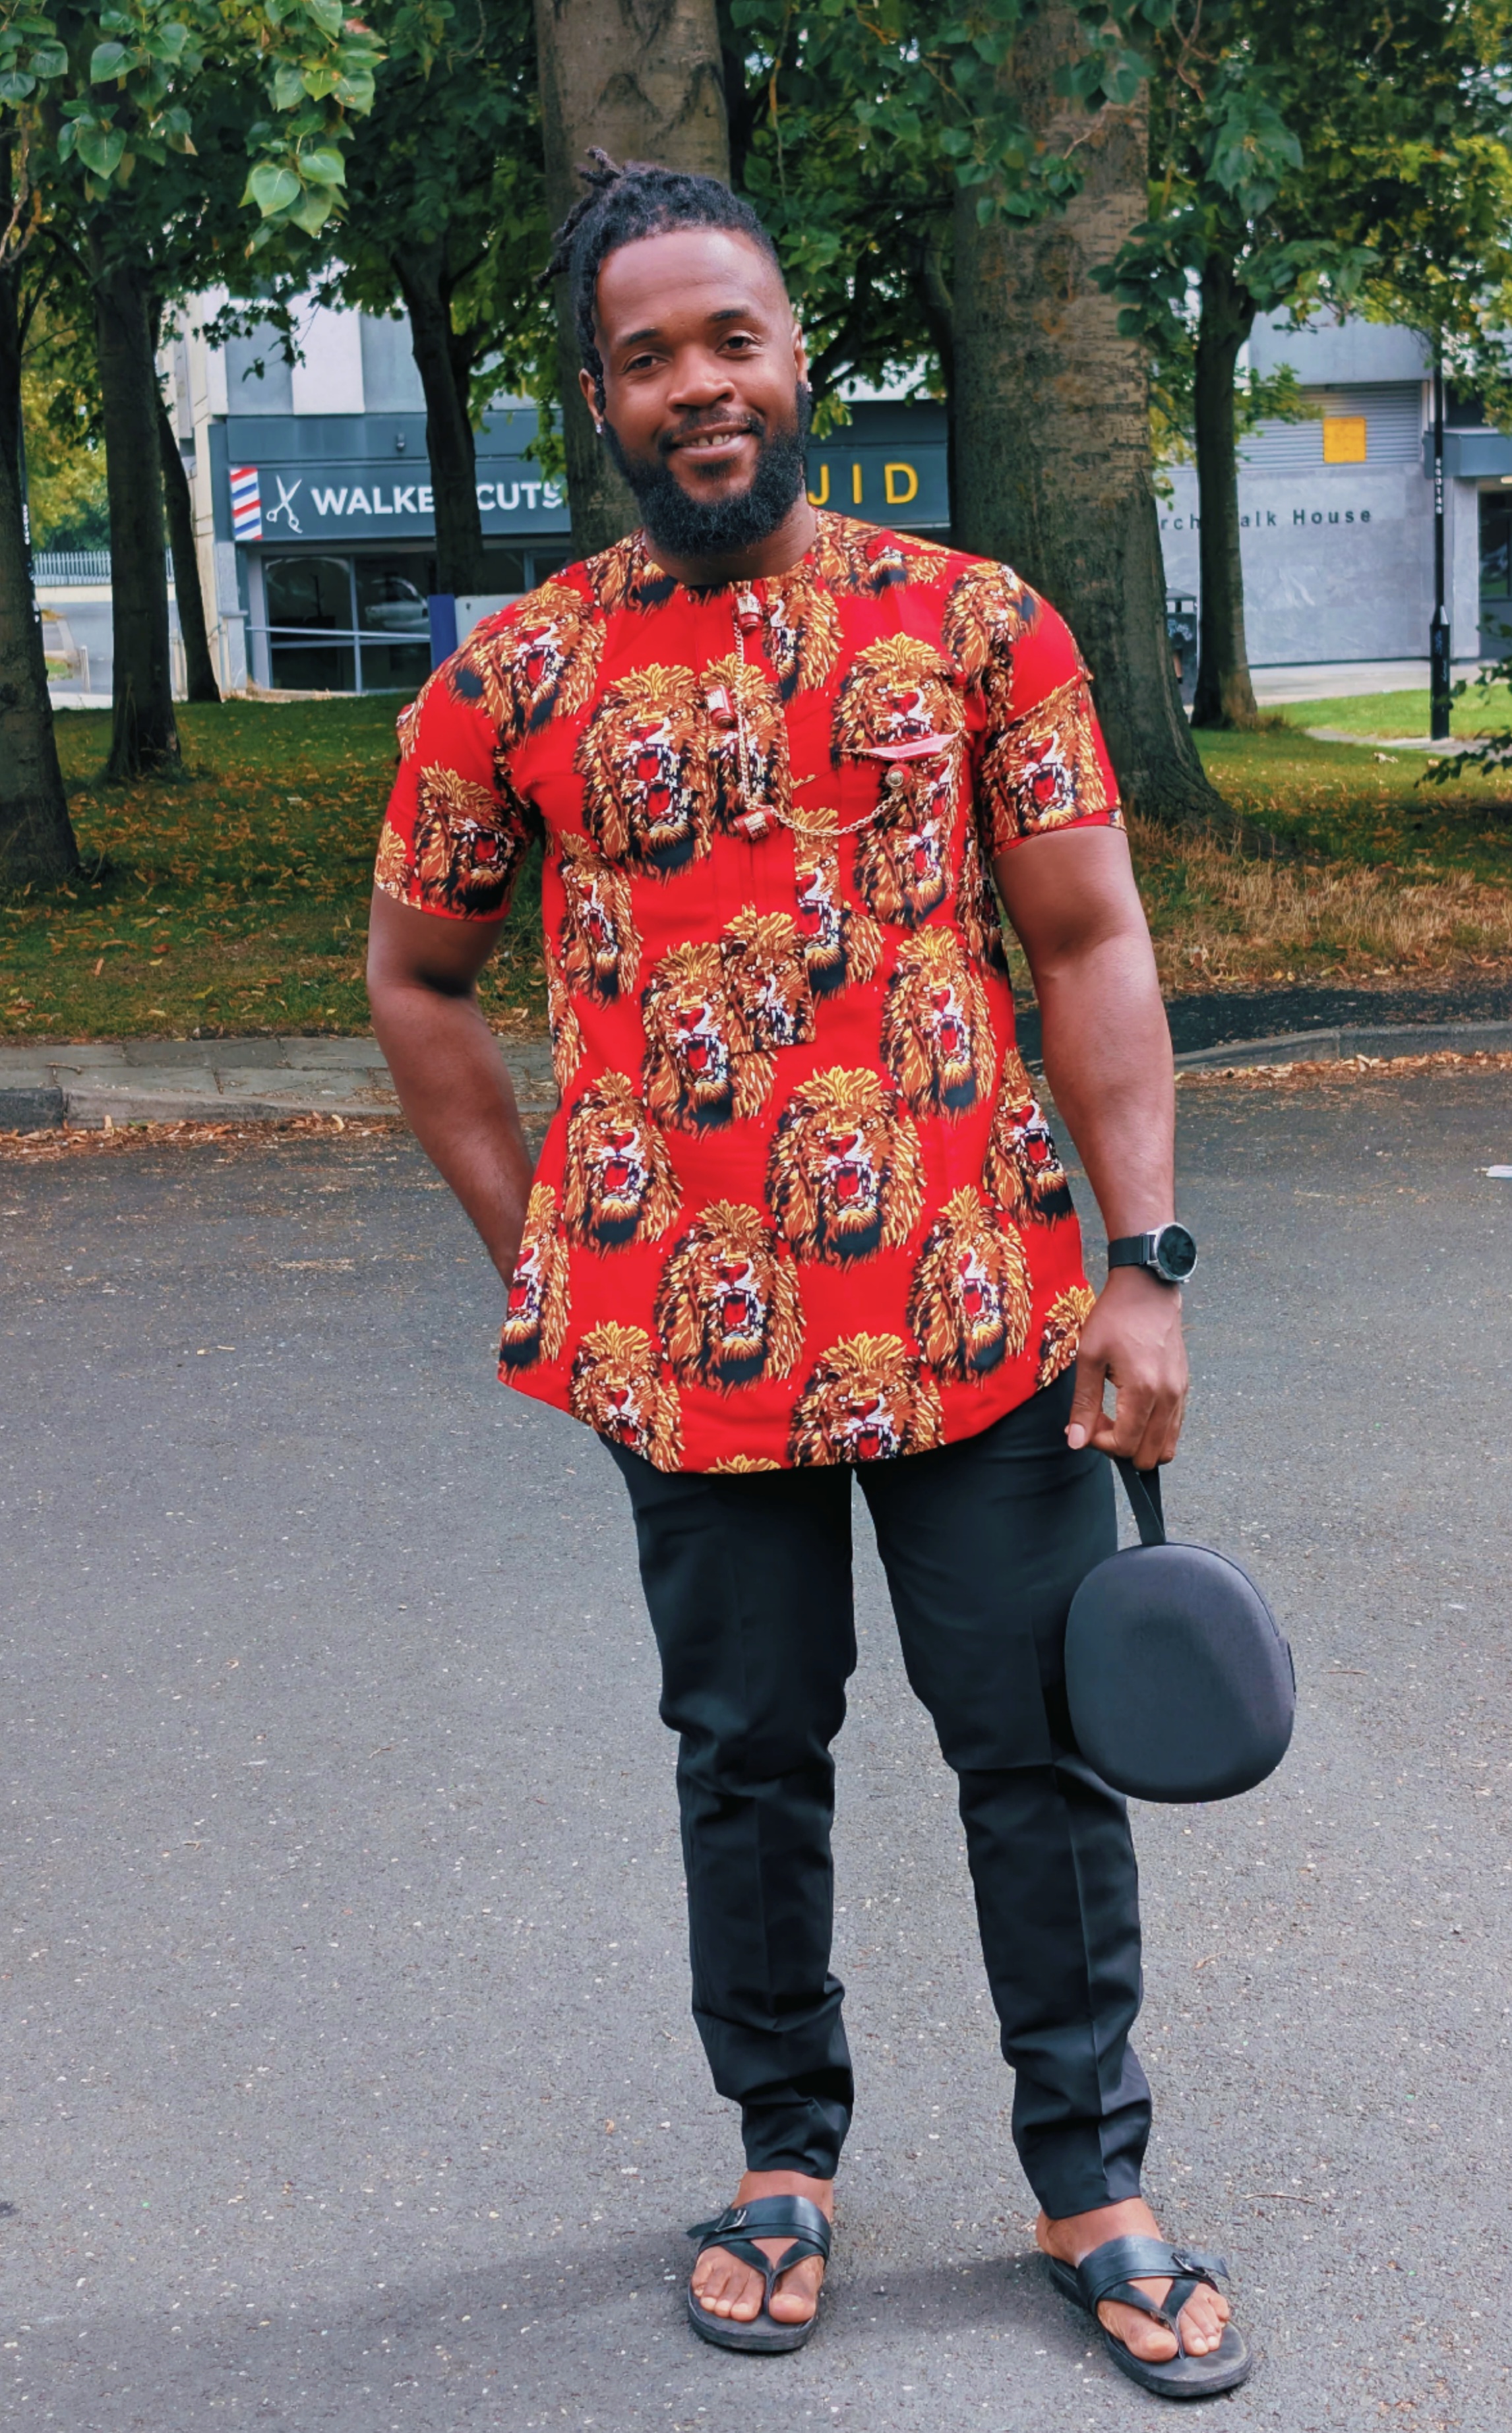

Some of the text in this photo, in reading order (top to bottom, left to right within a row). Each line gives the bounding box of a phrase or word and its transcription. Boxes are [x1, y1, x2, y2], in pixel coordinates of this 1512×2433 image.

[310, 482, 563, 516] WALKE CUTS
[806, 463, 919, 506] JID
[1160, 509, 1371, 530] rch alk House
